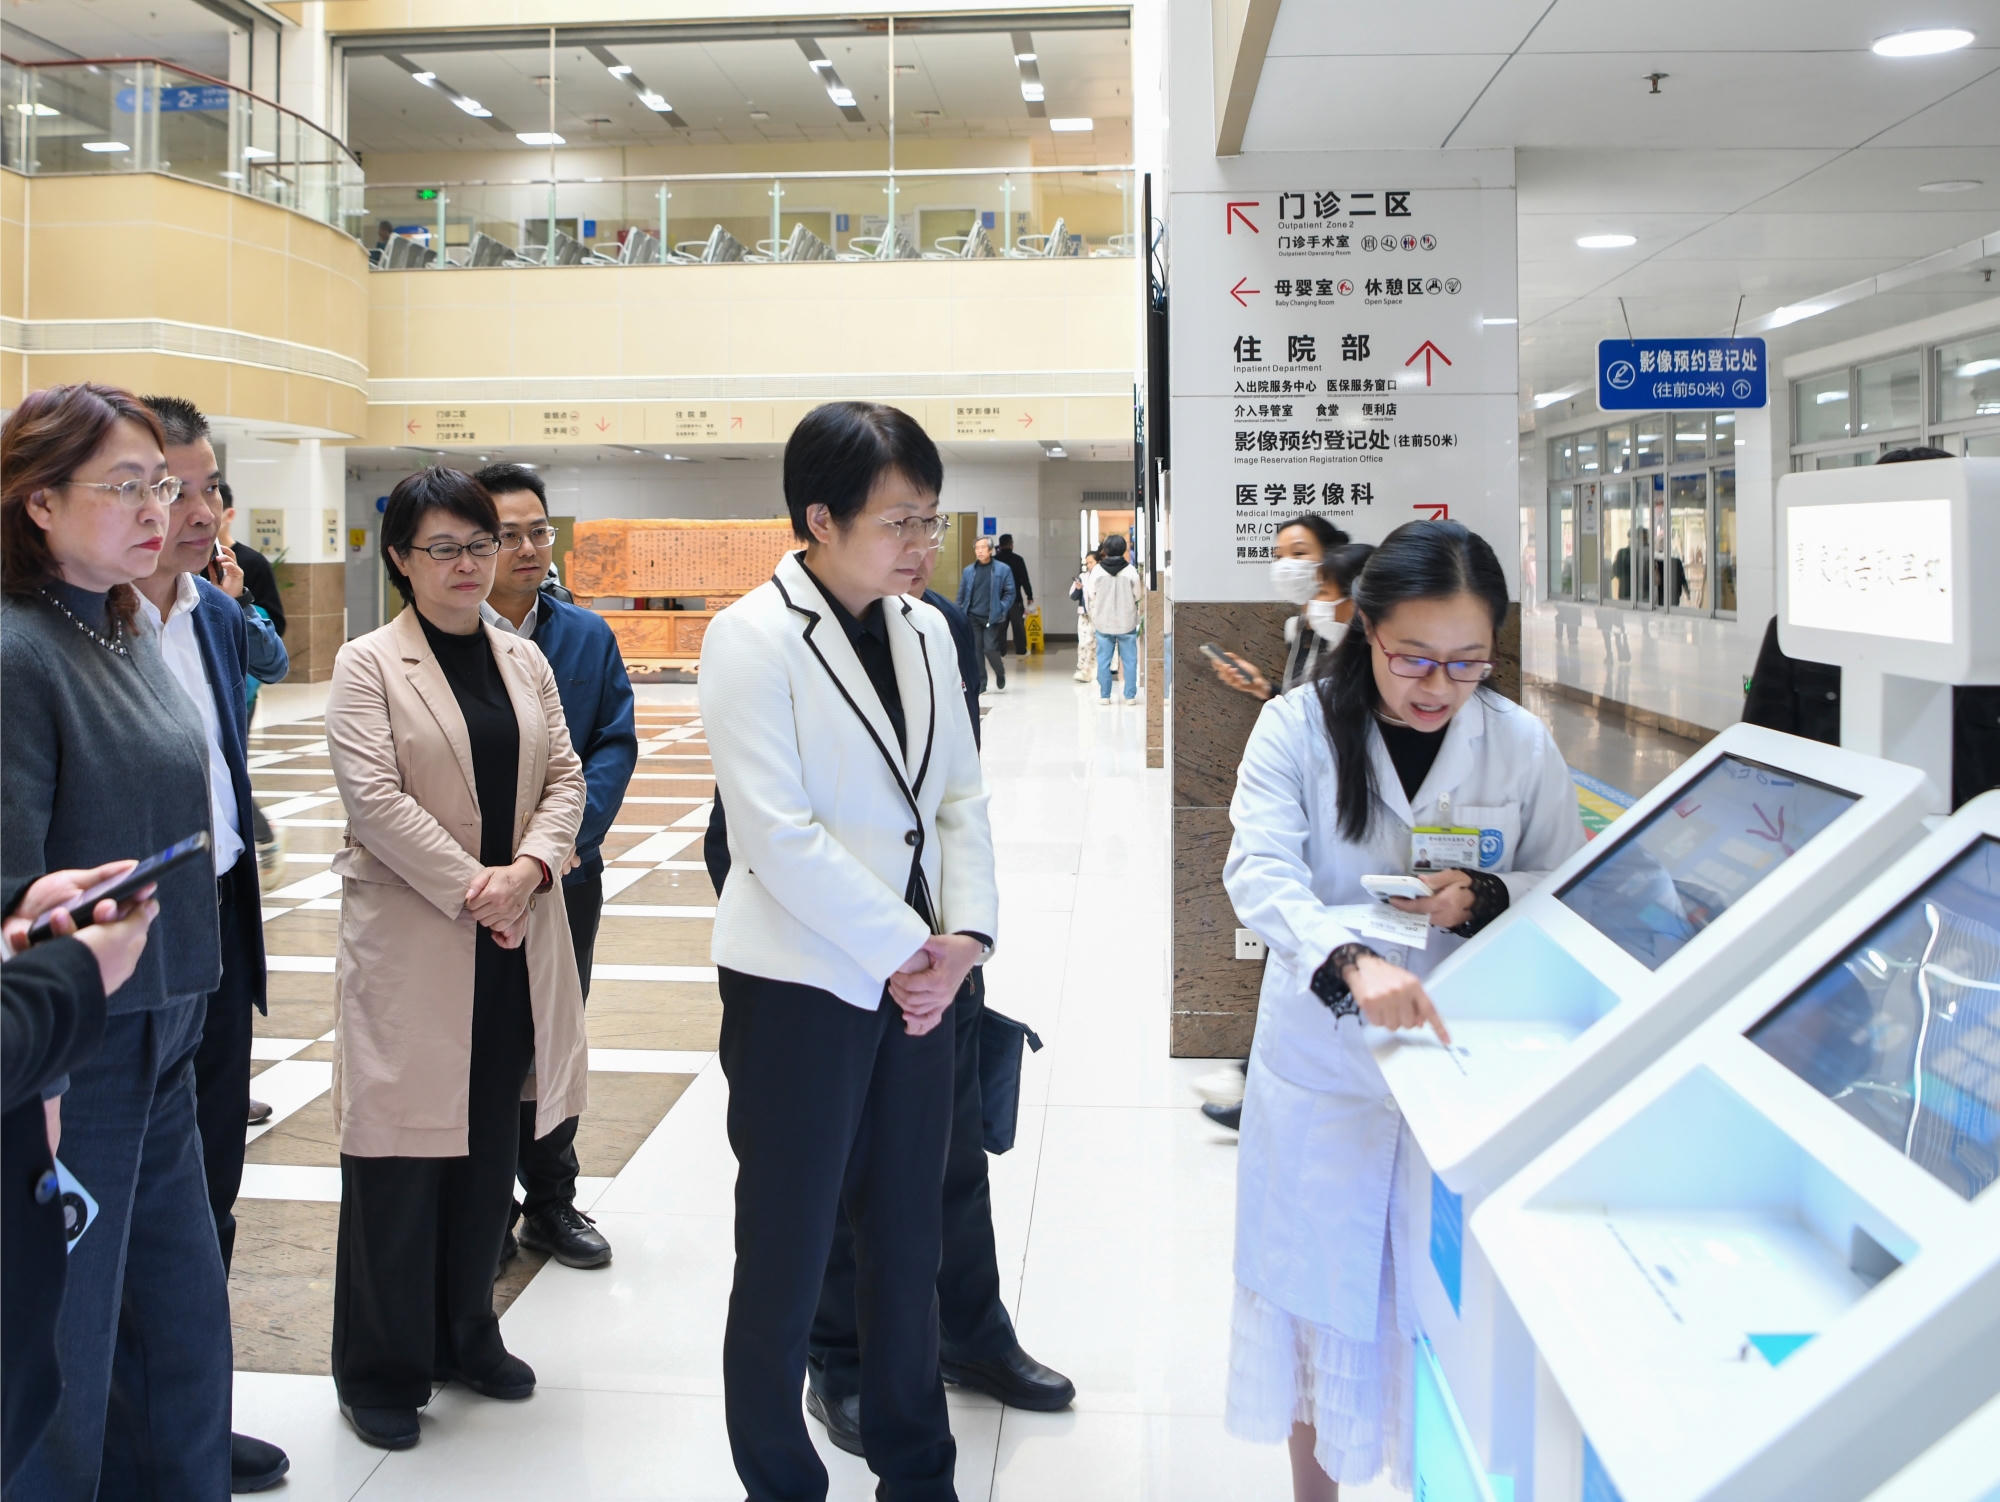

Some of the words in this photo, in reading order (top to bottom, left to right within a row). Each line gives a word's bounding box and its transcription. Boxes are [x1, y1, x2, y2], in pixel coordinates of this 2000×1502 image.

[1278, 191, 1412, 219] 门诊二区
[1278, 221, 1322, 230] Outpatient
[1326, 221, 1348, 229] Zone
[1278, 234, 1350, 249] 门诊手术室
[1275, 278, 1334, 297] 母婴室
[1364, 277, 1425, 296] 休憩区
[1364, 298, 1383, 306] Open
[1383, 298, 1403, 306] Space
[1233, 333, 1371, 363] 住院部
[1639, 349, 1758, 373] 影像预约登记处
[1233, 365, 1271, 373] Inpatient
[1272, 365, 1322, 373] Department
[1234, 379, 1317, 393] 入出院服务中心
[1326, 378, 1398, 392] 医保服务窗口
[1652, 381, 1725, 398] (往前50米)
[1234, 404, 1293, 417] 介入导管室
[1316, 403, 1339, 416] 食堂
[1362, 403, 1397, 416] 便利店
[1234, 429, 1390, 452] 影像预约登记处
[1393, 433, 1458, 448] (往前50米)
[1234, 456, 1257, 465] Image
[1259, 455, 1308, 464] Reservation
[1309, 455, 1359, 465] Registration
[1359, 454, 1384, 463] Office
[1235, 482, 1375, 506] 医学影像科
[1236, 509, 1269, 517] Medical
[1270, 509, 1303, 518] Imaging
